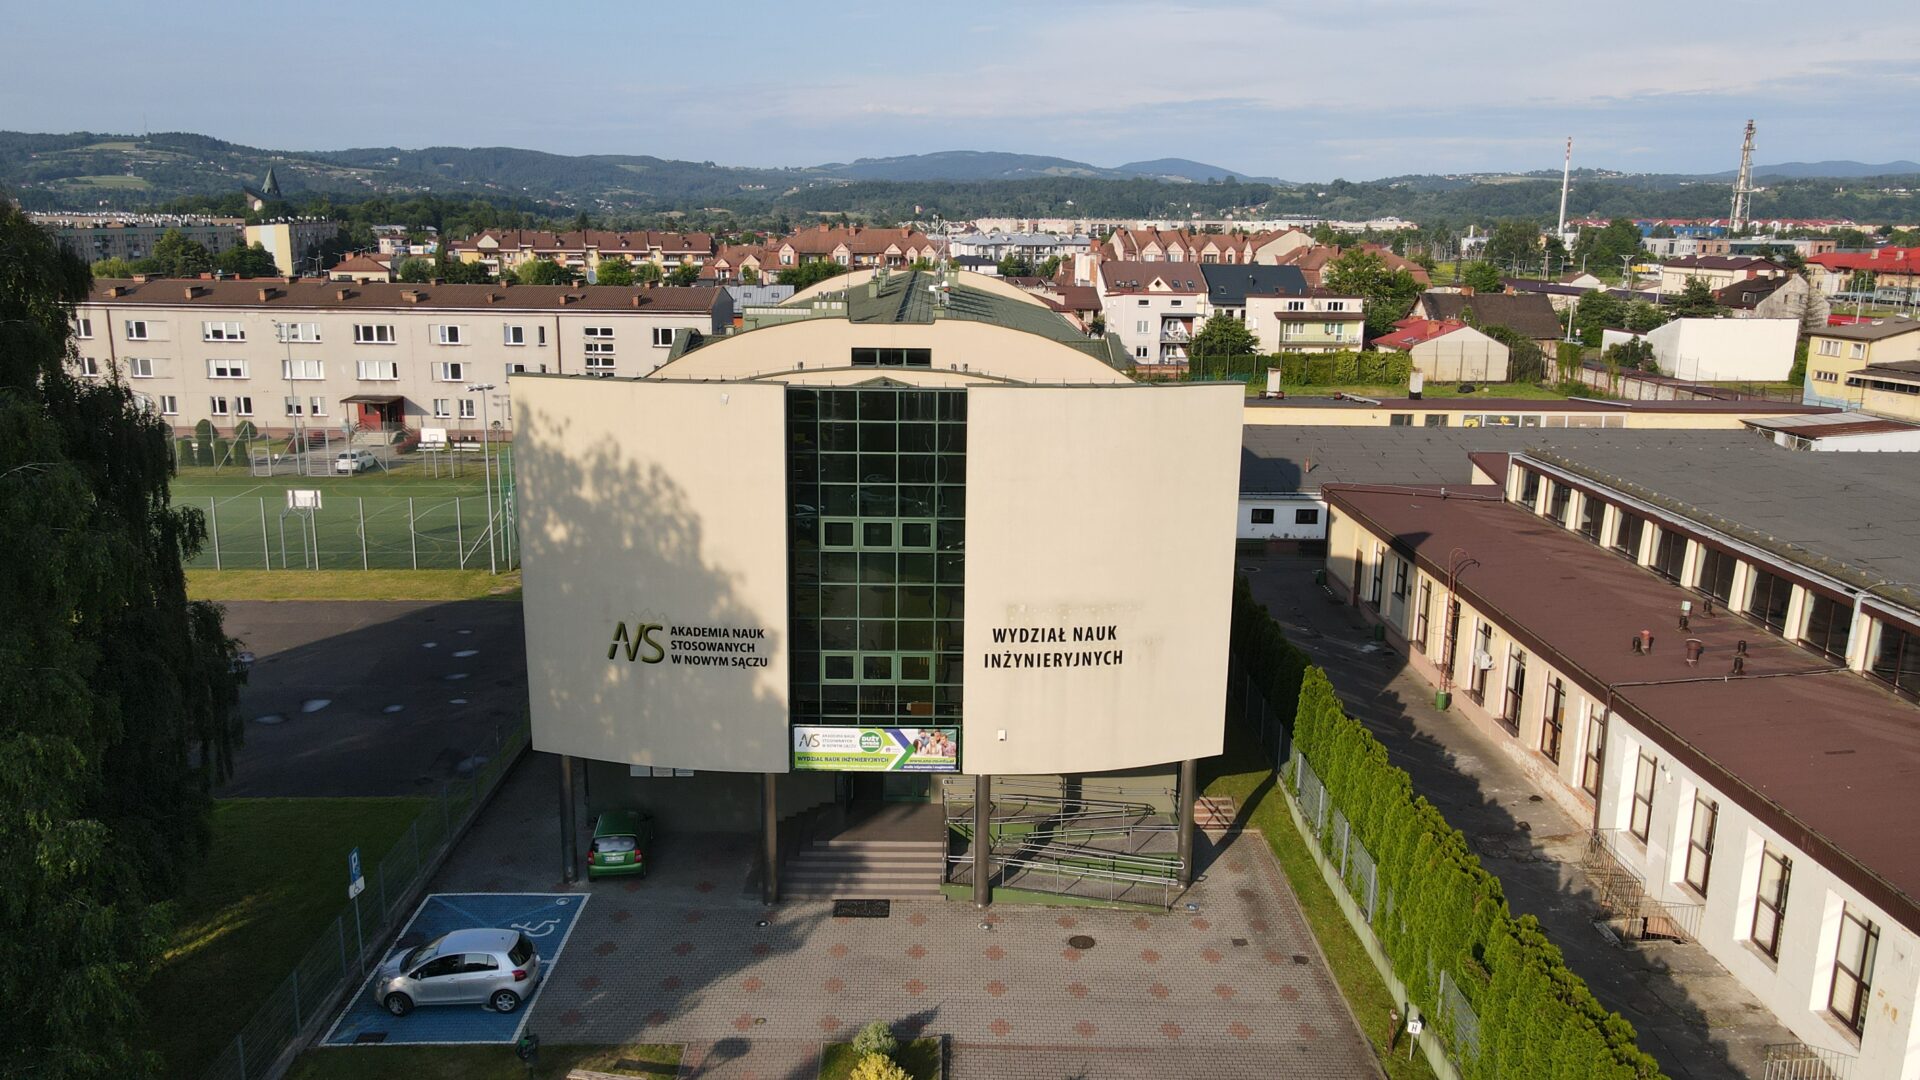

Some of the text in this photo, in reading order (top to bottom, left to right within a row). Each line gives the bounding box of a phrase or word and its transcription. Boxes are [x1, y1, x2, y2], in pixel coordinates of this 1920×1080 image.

[670, 626, 765, 639] AKADEMIA NAUK
[992, 625, 1117, 643] WYDZIAŁ NAUK
[670, 640, 755, 653] STOSOWANYCH
[672, 654, 768, 669] W NOWYM SĄCZU
[984, 649, 1123, 668] INŻYNIERYJNYCH
